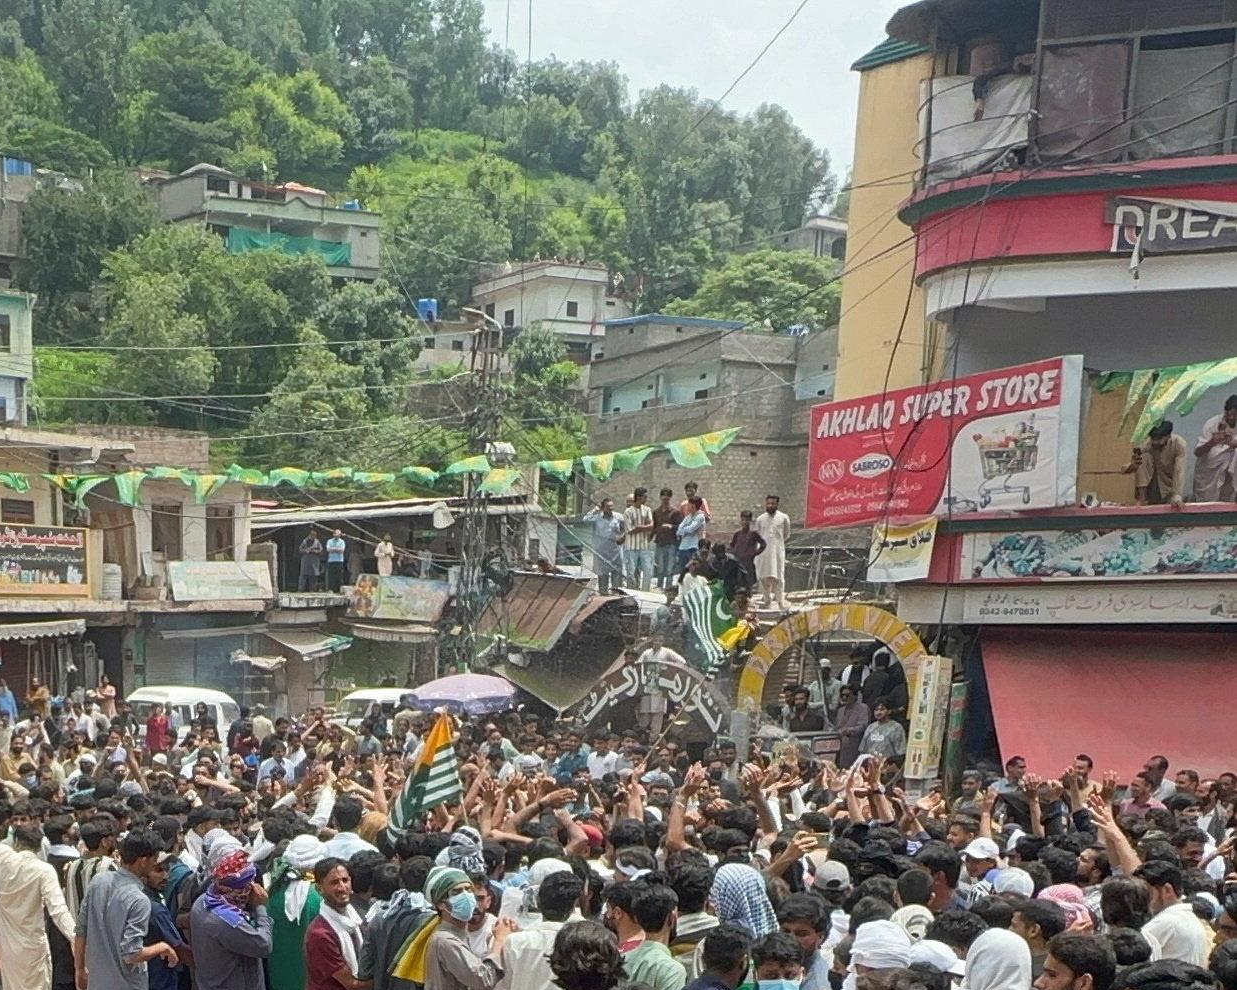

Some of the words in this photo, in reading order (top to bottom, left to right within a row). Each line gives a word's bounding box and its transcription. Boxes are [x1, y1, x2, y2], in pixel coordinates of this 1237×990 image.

[816, 399, 895, 439] AKHLAQ
[899, 385, 971, 424] SUPER
[976, 368, 1059, 412] STORE
[852, 459, 890, 473] SABROSO
